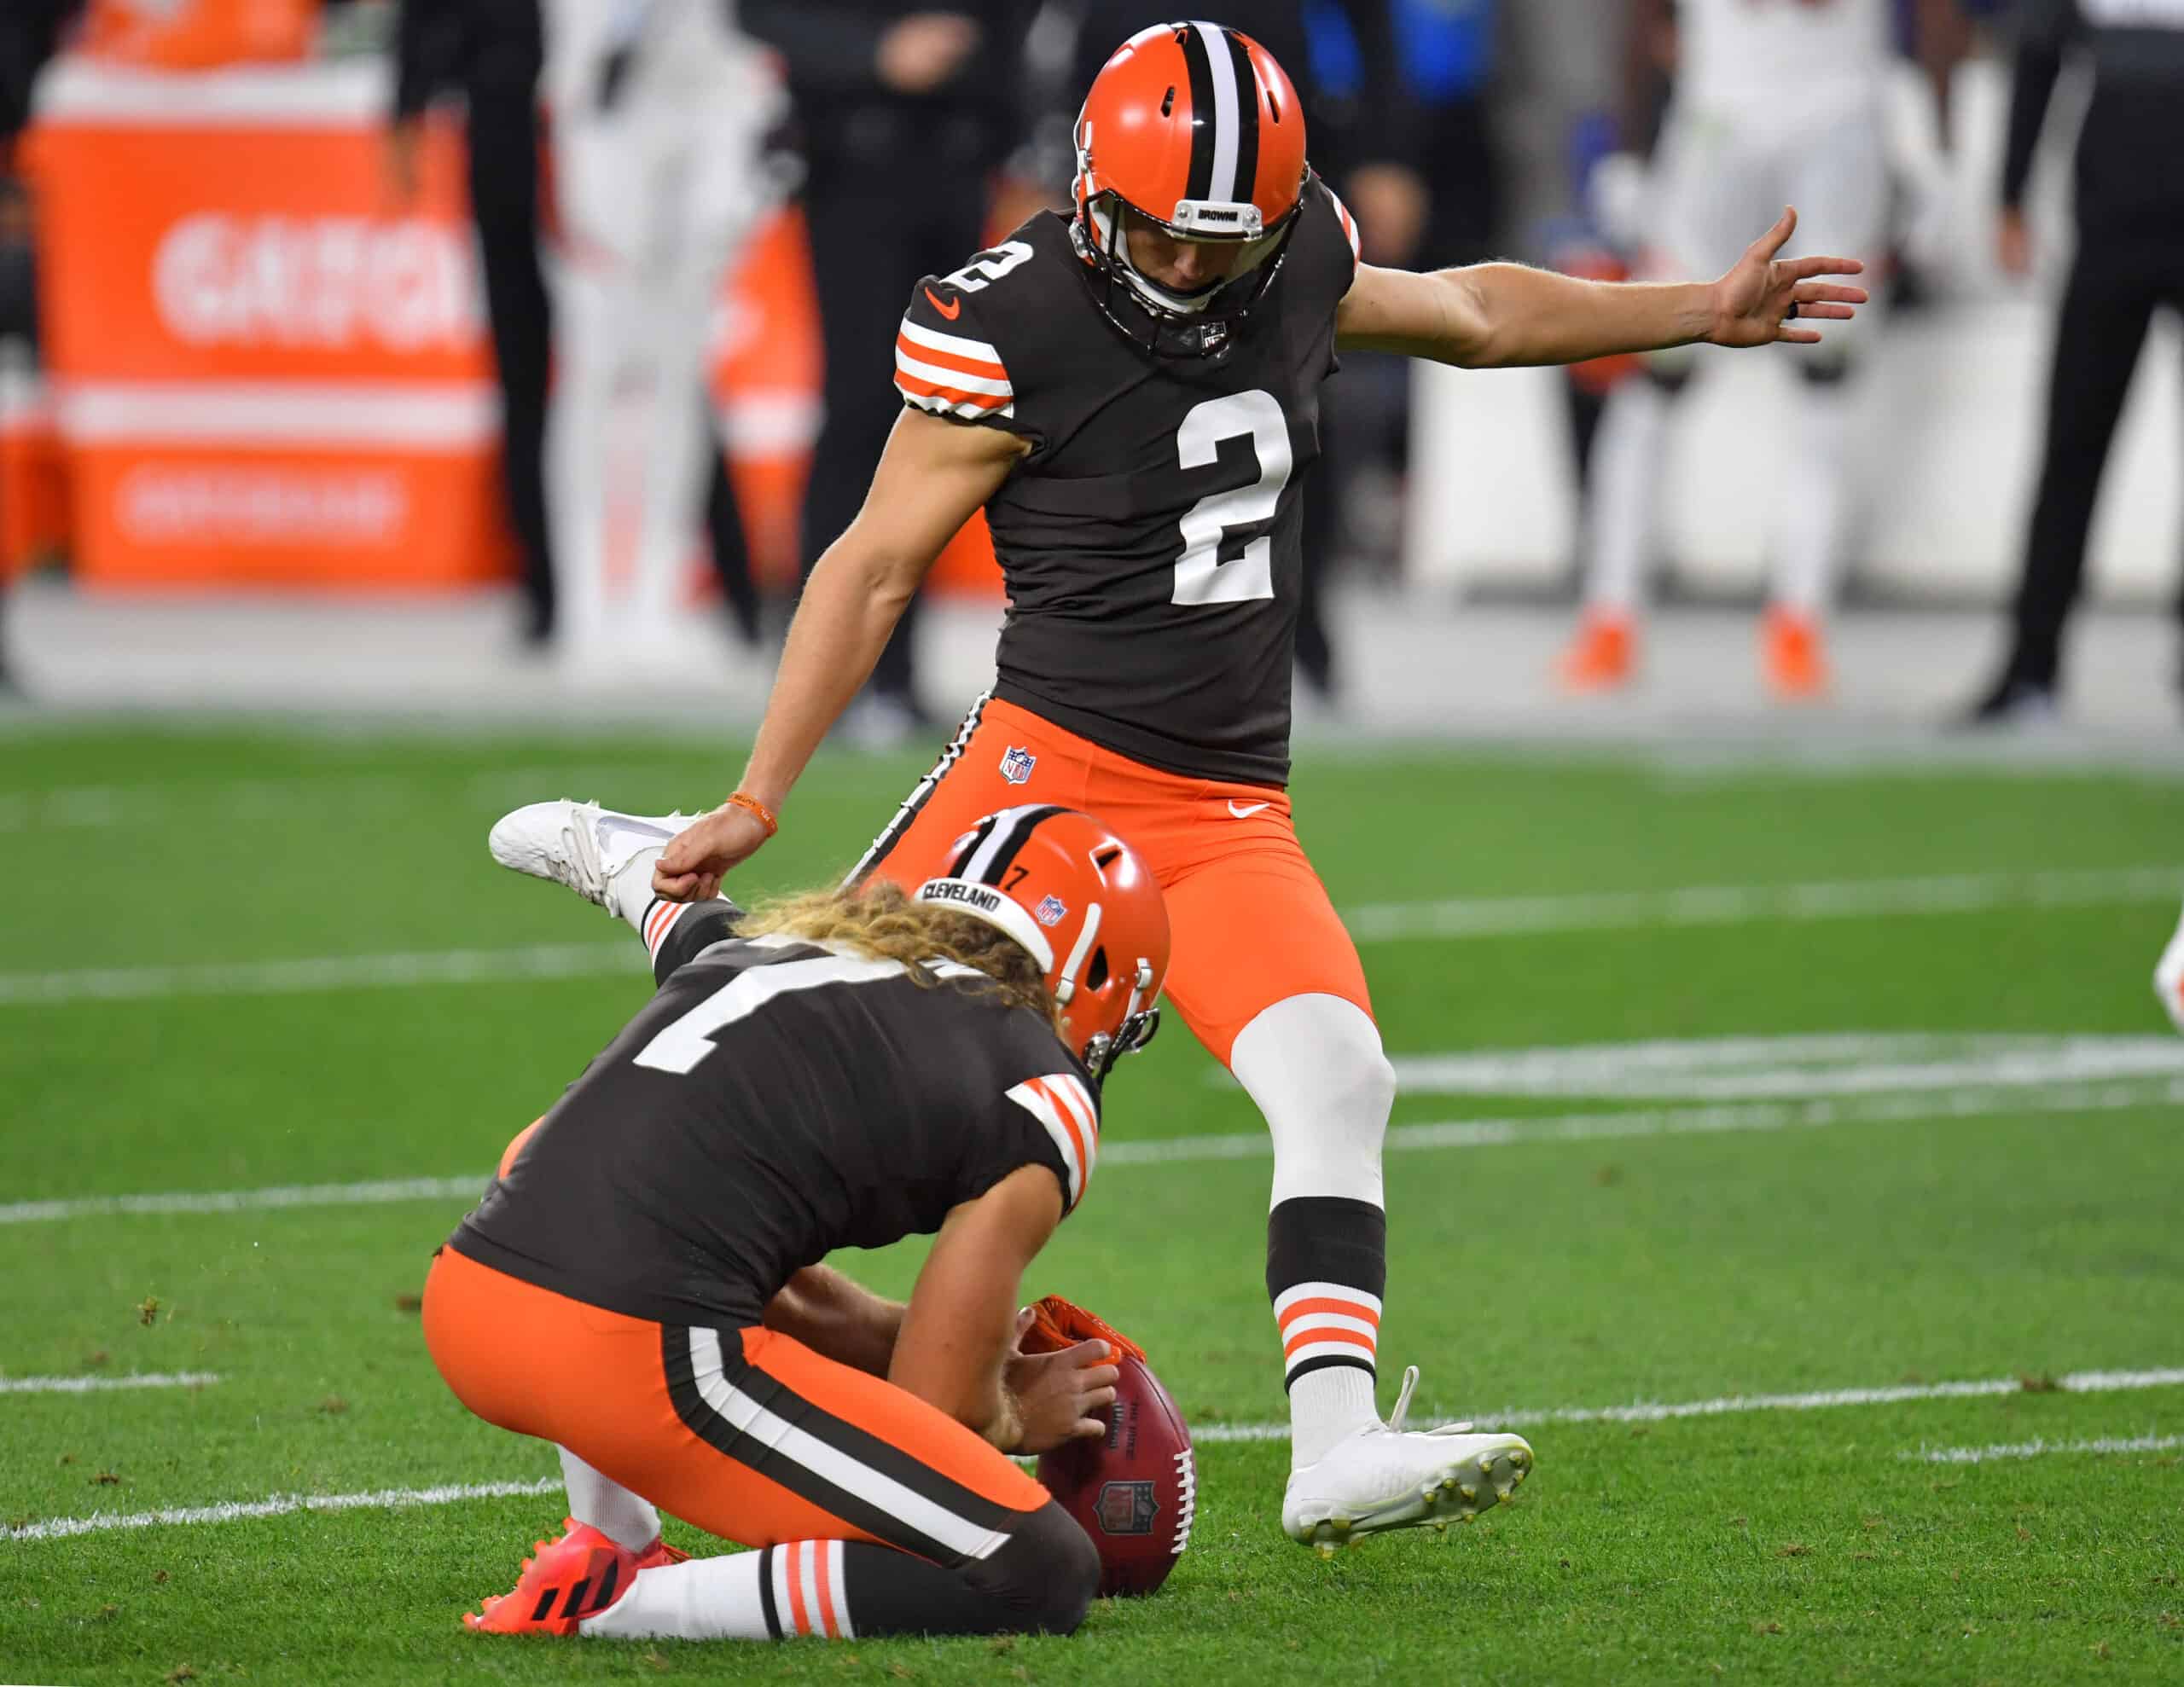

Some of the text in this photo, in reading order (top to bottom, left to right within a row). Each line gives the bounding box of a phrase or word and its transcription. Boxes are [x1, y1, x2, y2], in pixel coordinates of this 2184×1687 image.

[1198, 209, 1238, 222] BROWNS
[938, 241, 1033, 293] 2
[1171, 389, 1292, 606] 2
[922, 883, 1001, 913] CLEVELAND
[1005, 866, 1029, 891] 7
[633, 934, 909, 1075] 7
